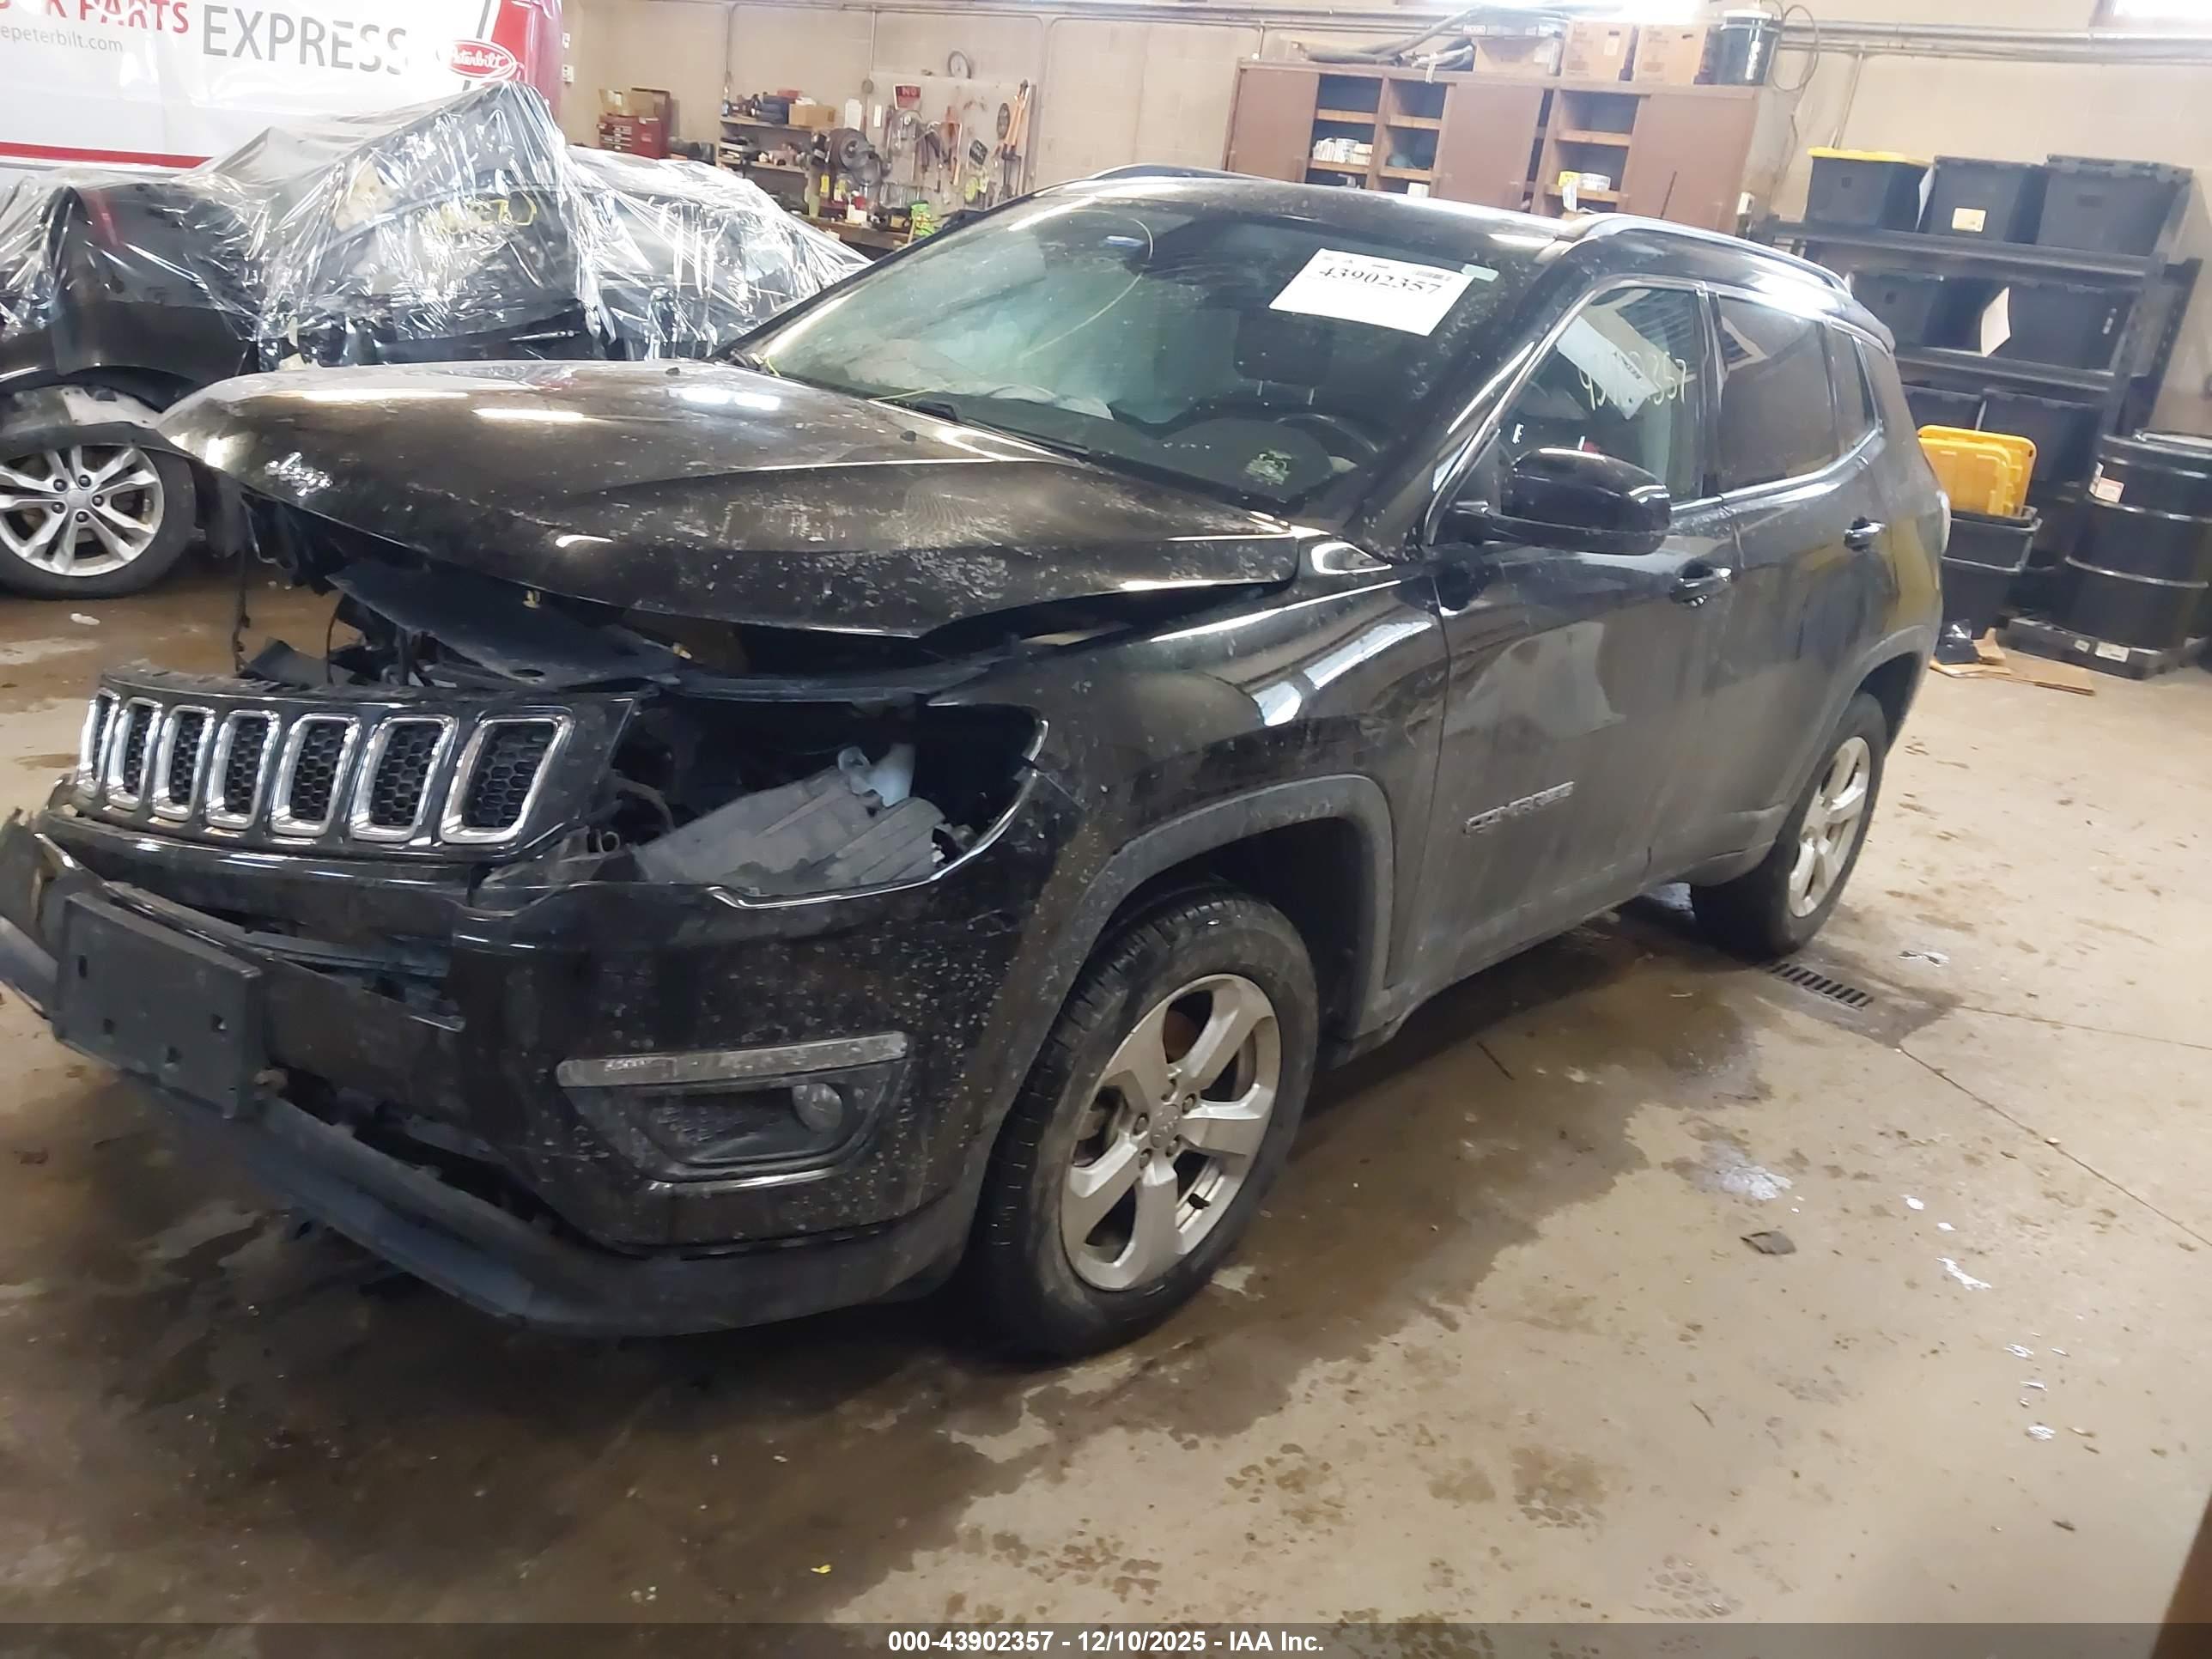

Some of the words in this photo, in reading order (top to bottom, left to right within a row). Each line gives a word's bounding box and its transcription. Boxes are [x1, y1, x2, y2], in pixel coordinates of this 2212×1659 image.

[79, 0, 189, 33] PARTS
[203, 4, 408, 76] EXPRESS
[1318, 266, 1443, 295] 43902357
